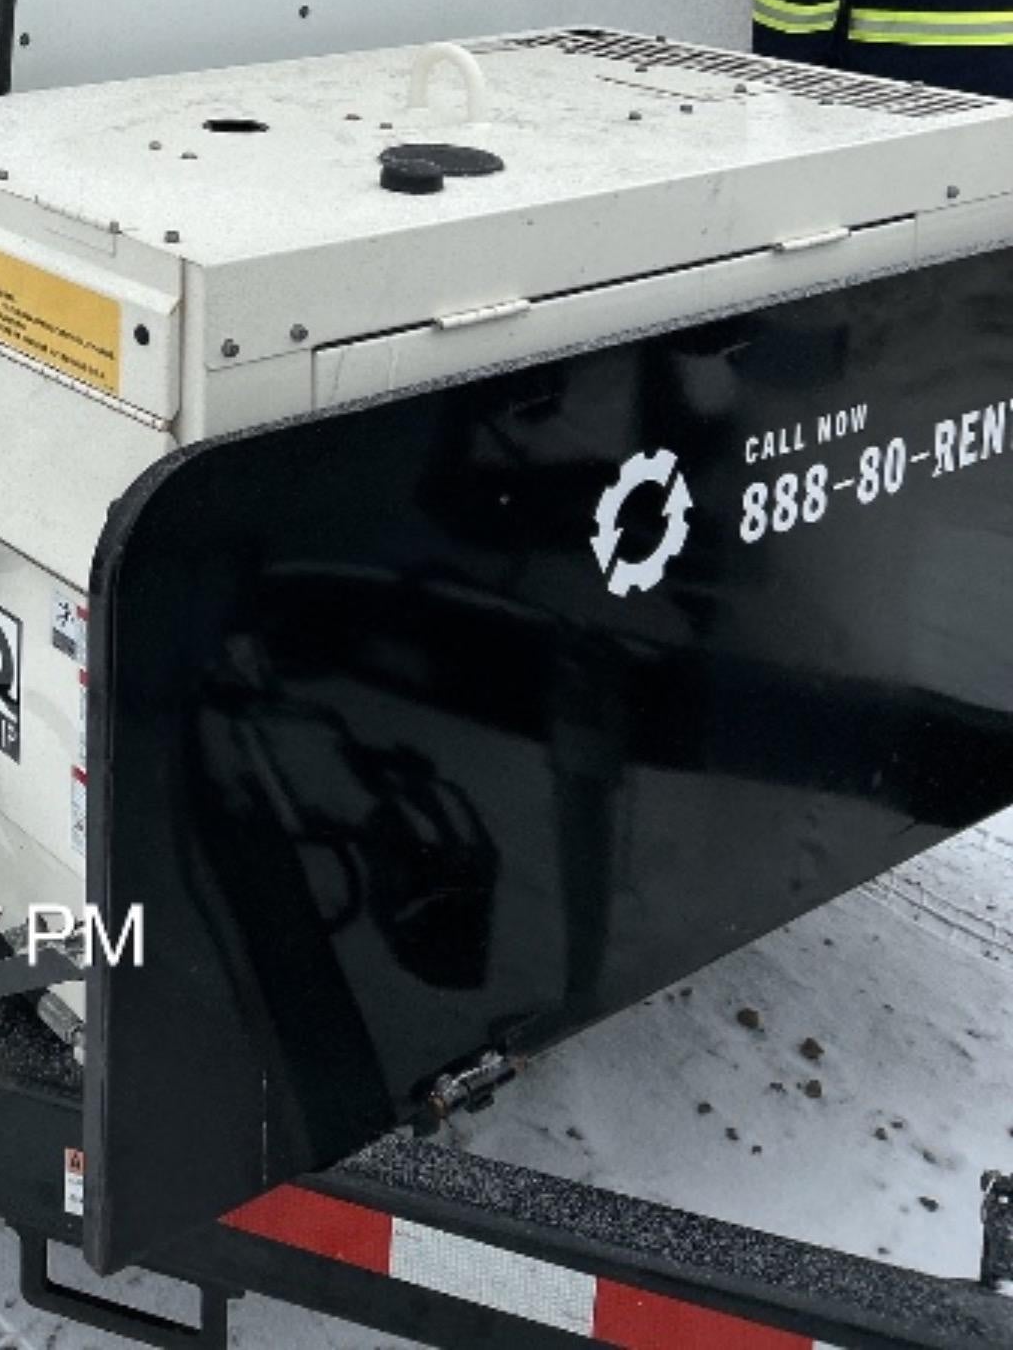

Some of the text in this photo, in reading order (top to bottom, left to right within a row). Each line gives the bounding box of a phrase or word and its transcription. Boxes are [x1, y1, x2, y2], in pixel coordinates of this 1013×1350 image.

[739, 398, 1013, 544] 888-80-REN
[744, 403, 868, 464] CALL NOW
